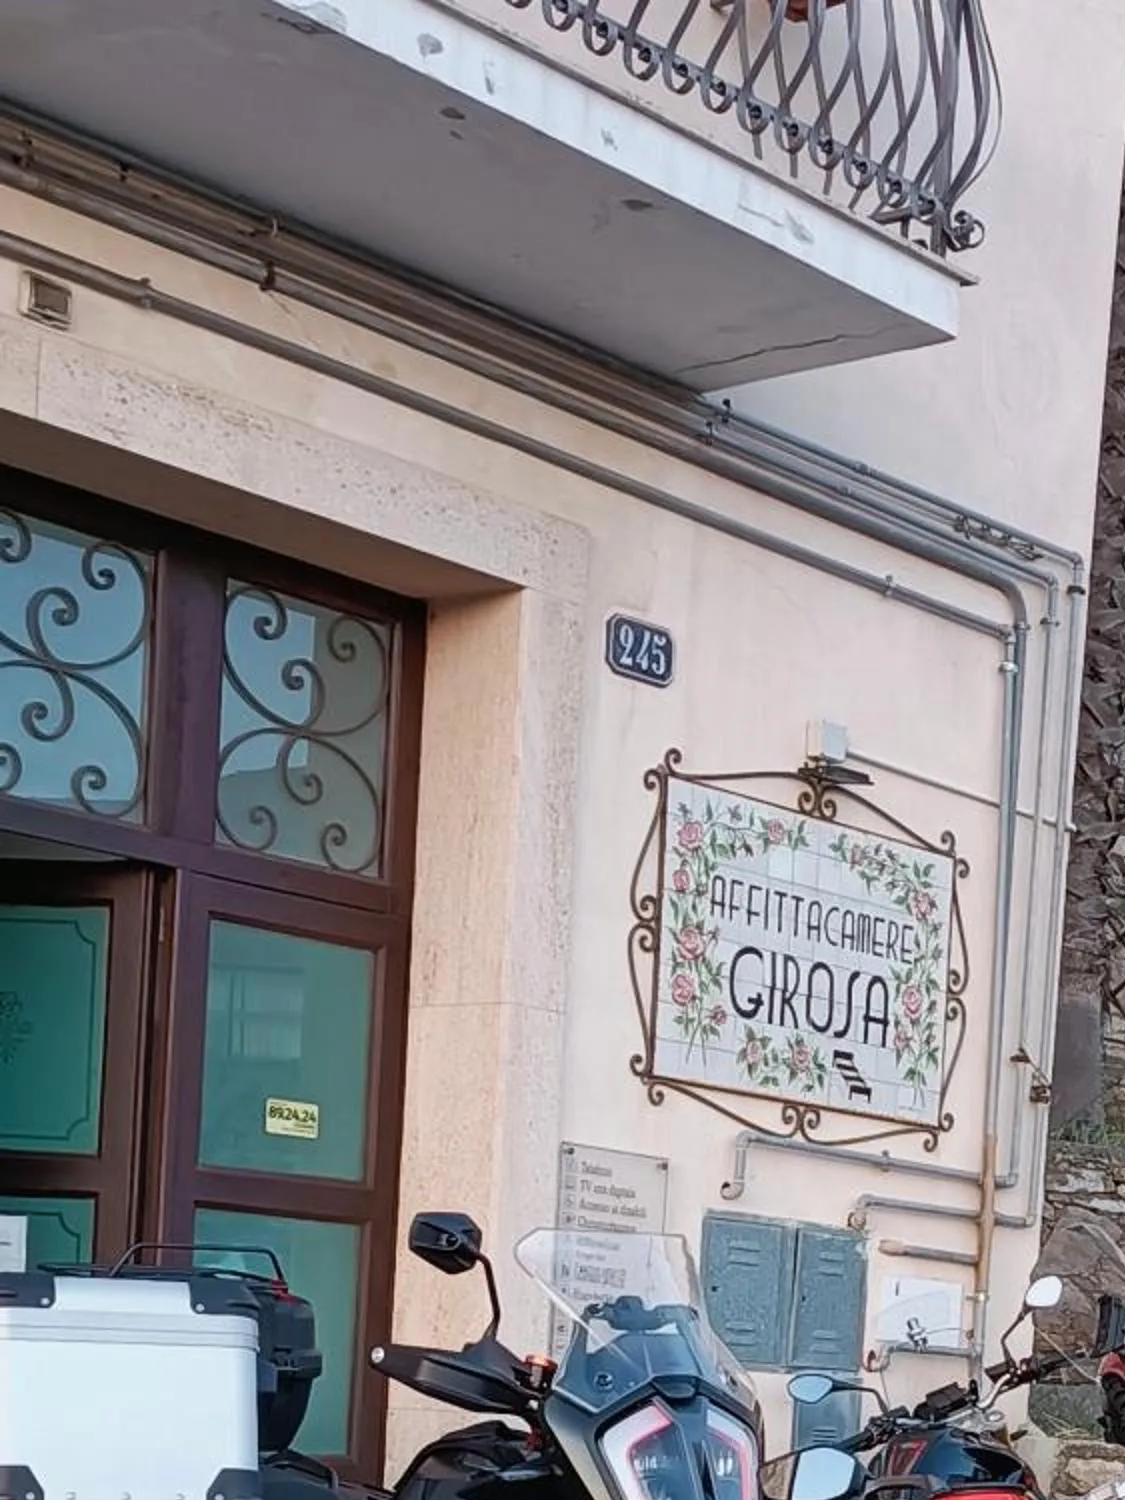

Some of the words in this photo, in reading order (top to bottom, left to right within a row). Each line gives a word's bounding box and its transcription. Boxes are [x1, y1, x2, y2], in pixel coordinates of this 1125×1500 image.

[619, 624, 667, 675] 245
[710, 875, 914, 965] AFFITTACAMERE
[729, 946, 890, 1049] GIROSA
